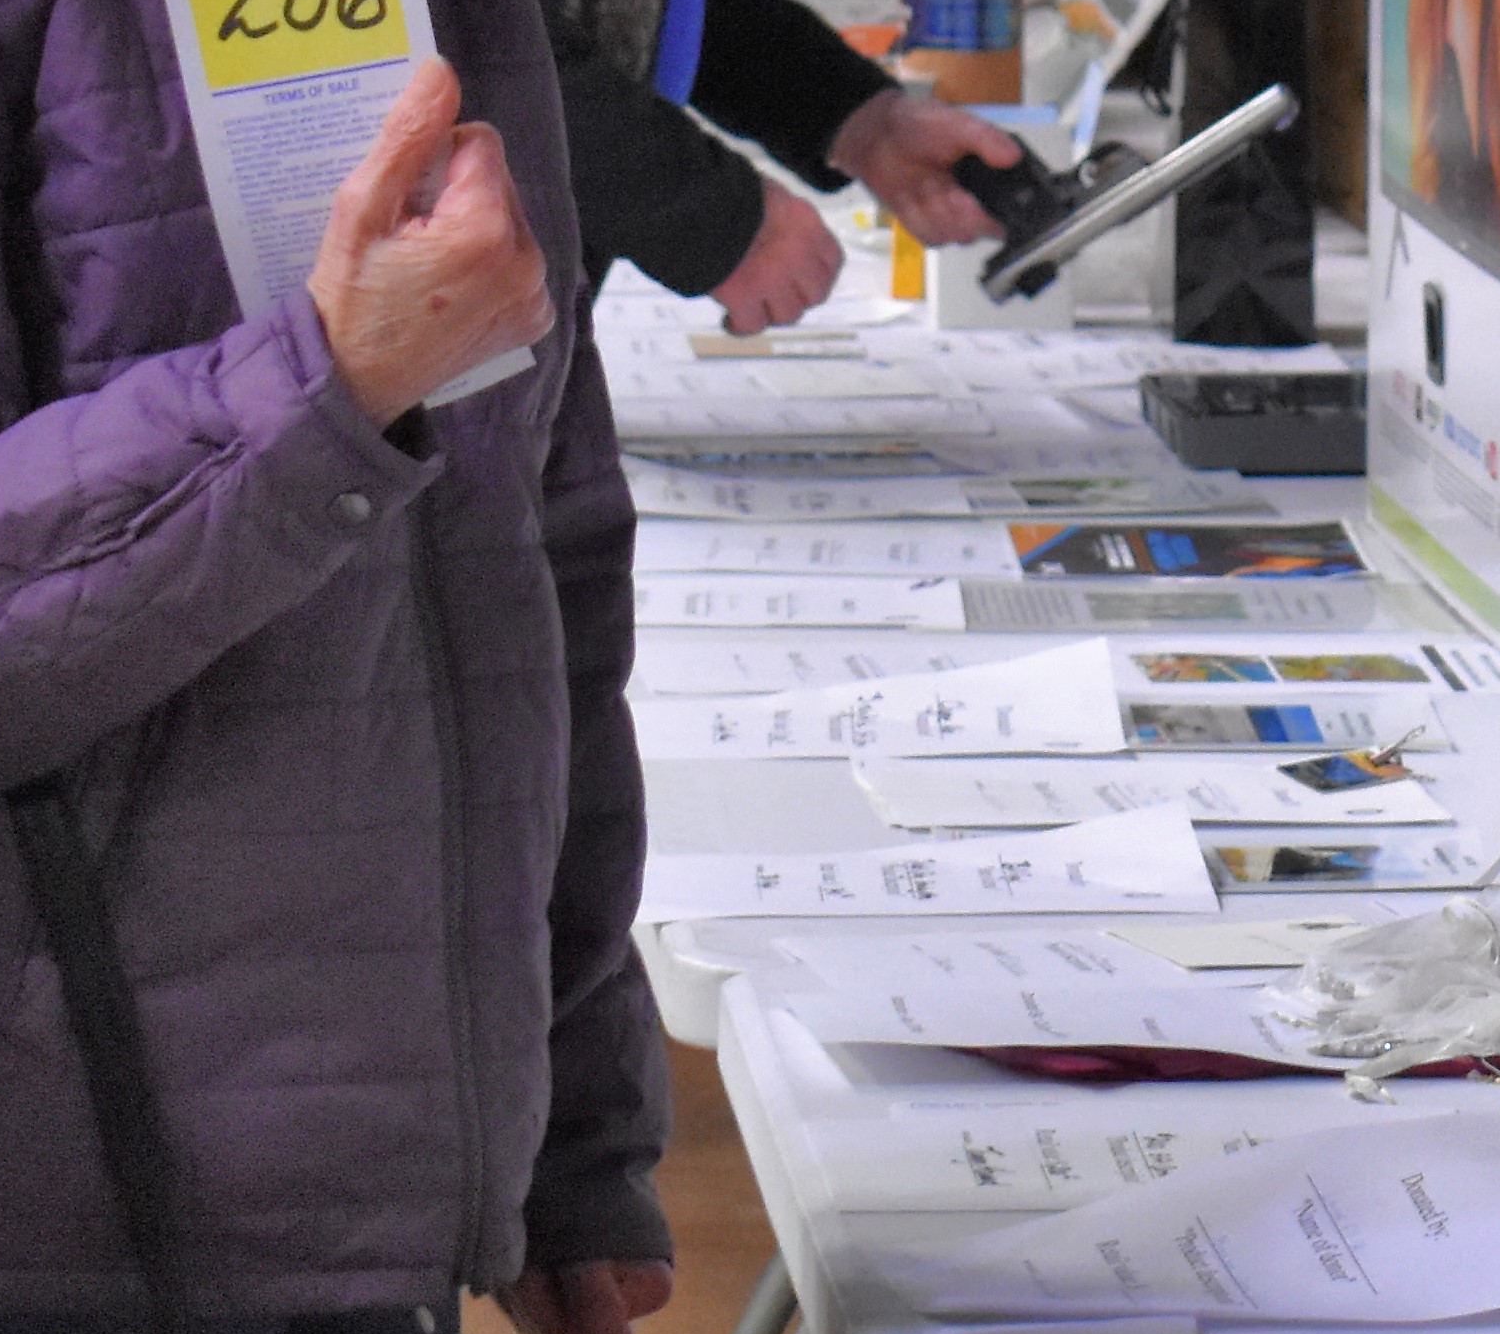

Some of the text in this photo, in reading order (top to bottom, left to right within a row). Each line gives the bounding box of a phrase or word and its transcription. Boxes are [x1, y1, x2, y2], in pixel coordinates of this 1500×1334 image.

[264, 77, 362, 107] TERMS OF SALE
